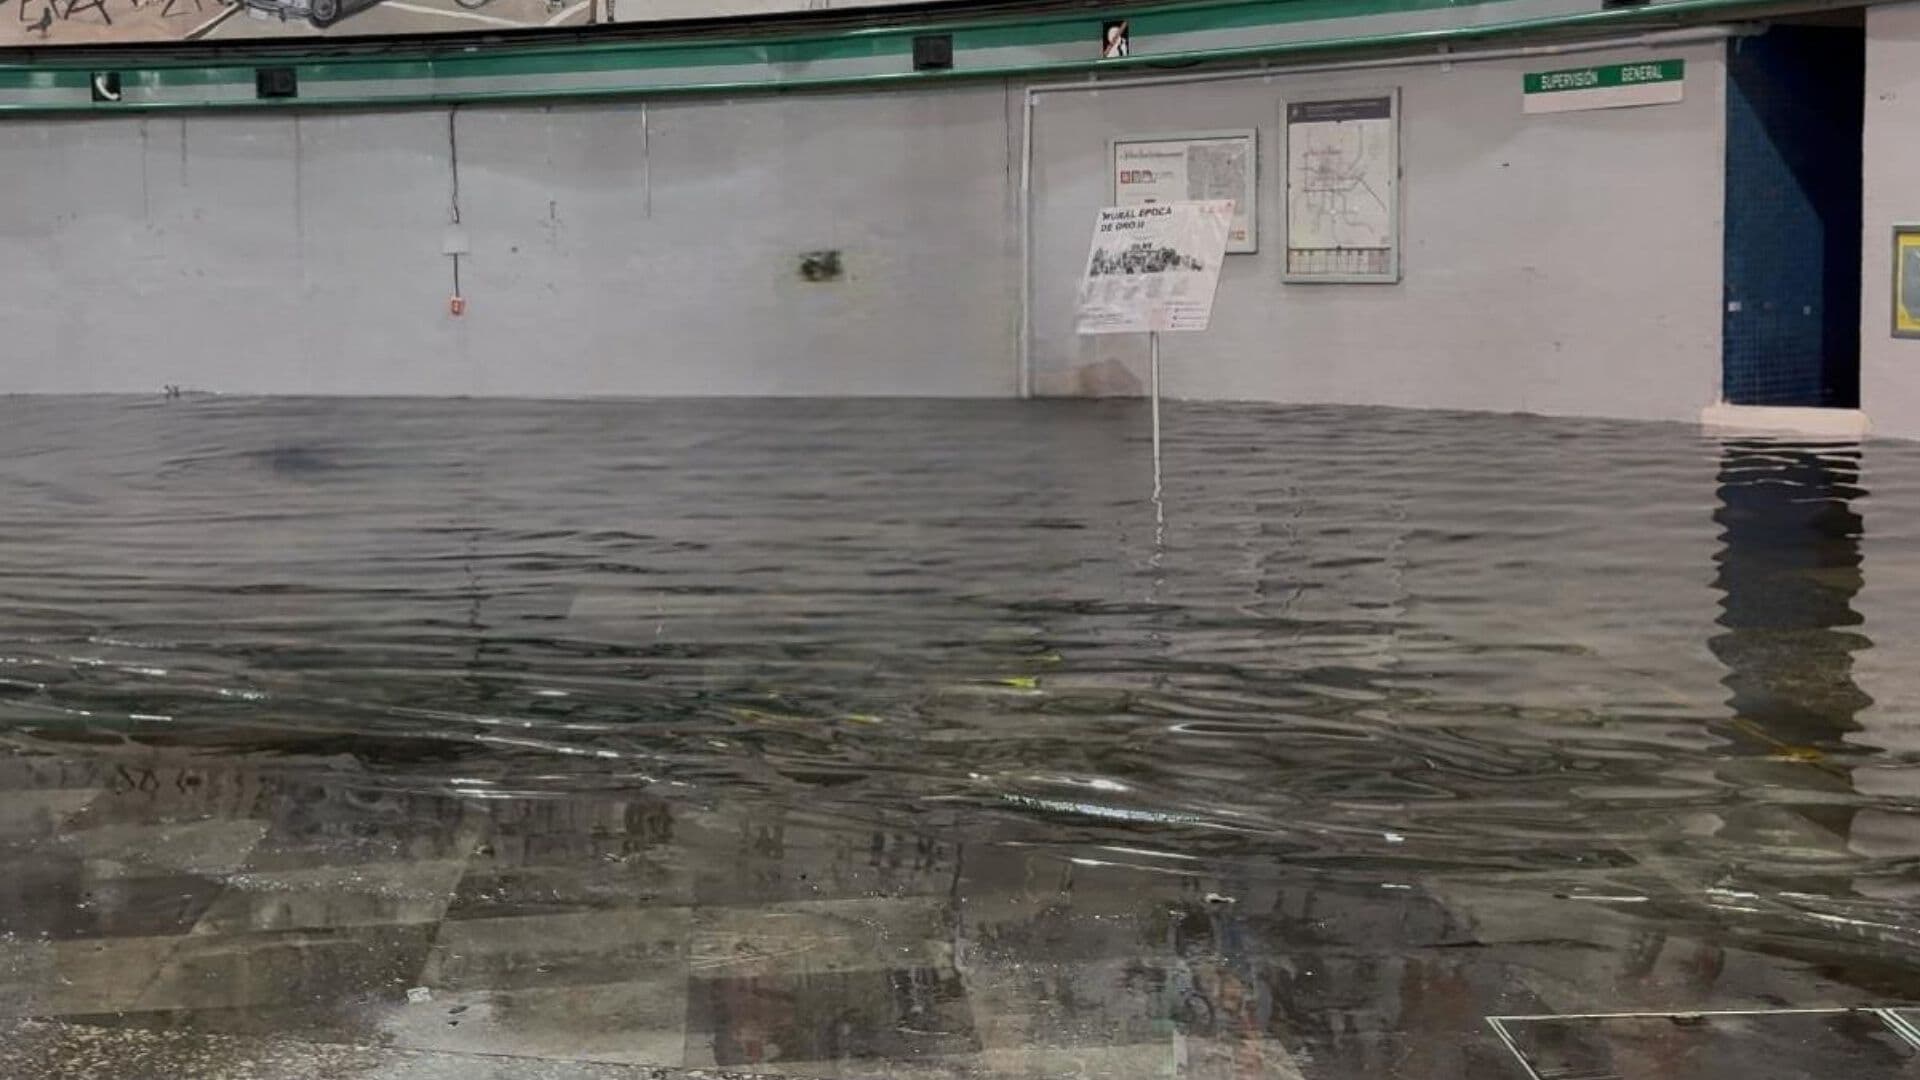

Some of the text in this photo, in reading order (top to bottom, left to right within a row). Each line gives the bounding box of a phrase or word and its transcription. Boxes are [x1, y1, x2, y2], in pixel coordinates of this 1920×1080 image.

[1541, 64, 1664, 90] SUPERVISIÓN GENERAL
[1102, 209, 1135, 221] MURAL
[1101, 223, 1112, 232] DE
